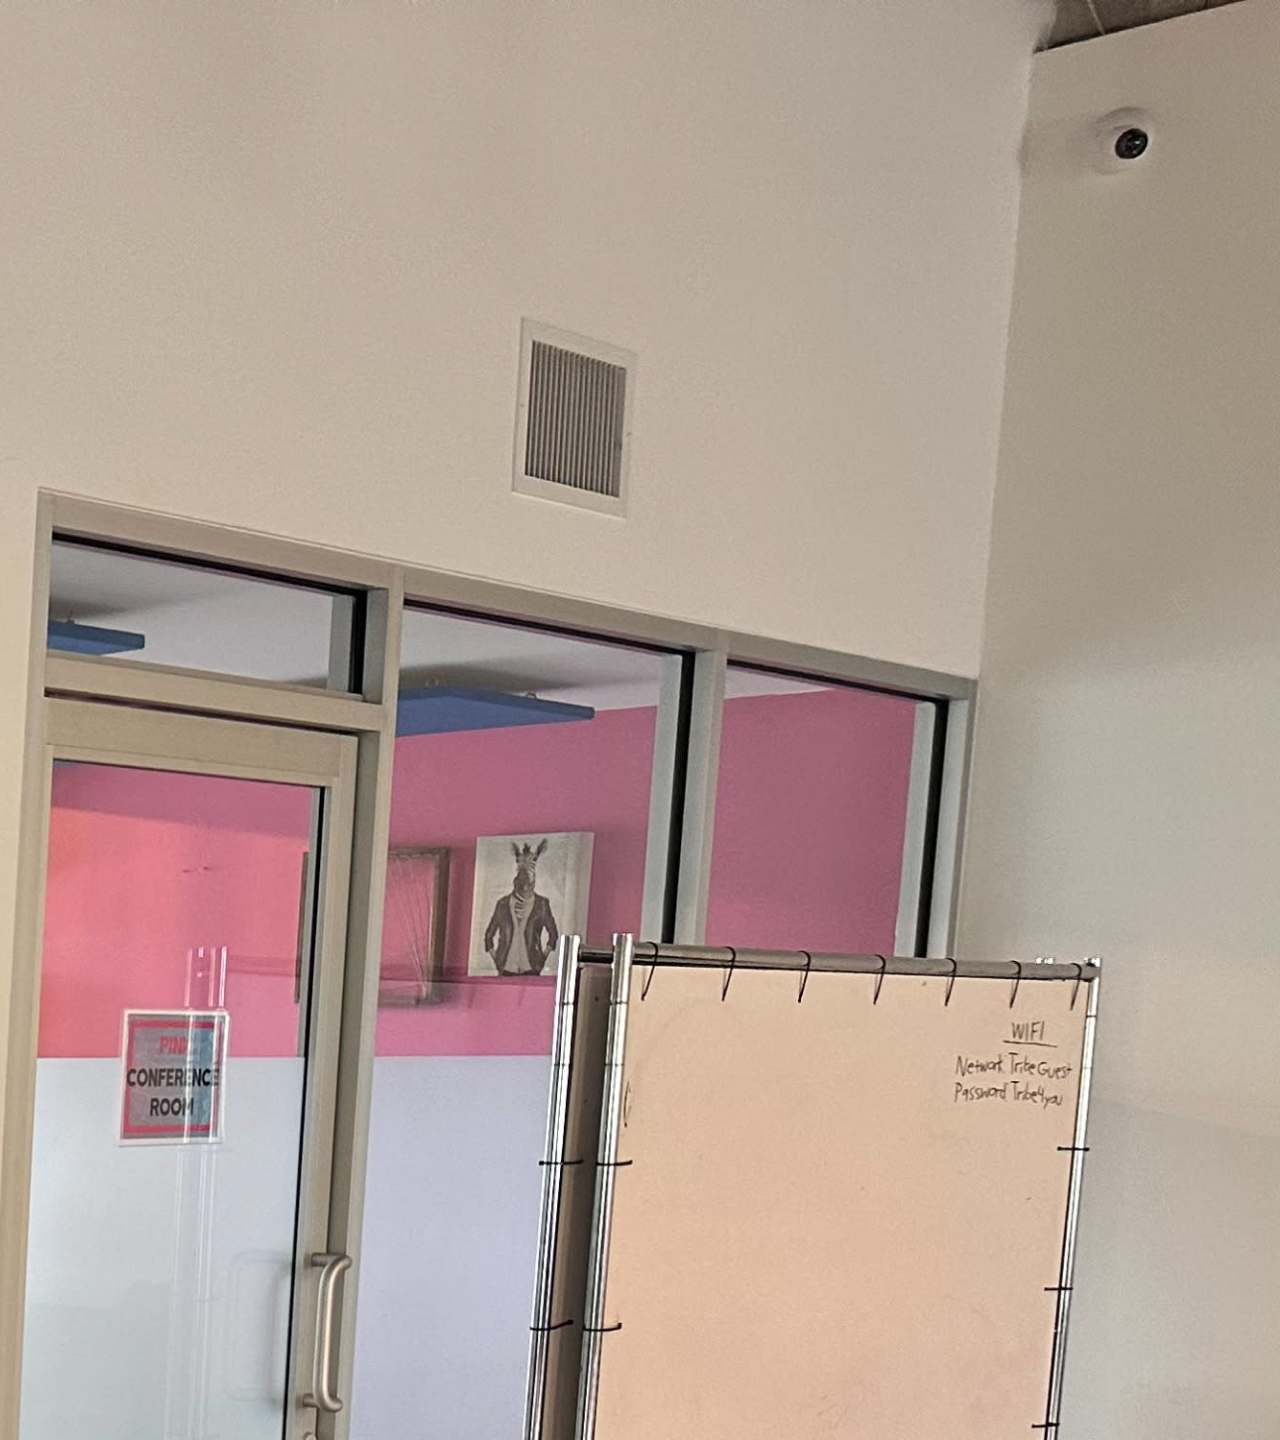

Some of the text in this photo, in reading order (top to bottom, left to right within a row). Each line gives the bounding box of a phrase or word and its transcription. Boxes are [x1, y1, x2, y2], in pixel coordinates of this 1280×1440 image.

[1011, 1020, 1045, 1041] WIFI
[159, 1035, 196, 1056] PIN
[955, 1053, 1003, 1077] Network
[954, 1081, 1008, 1103] Password
[150, 1097, 194, 1116] ROOM
